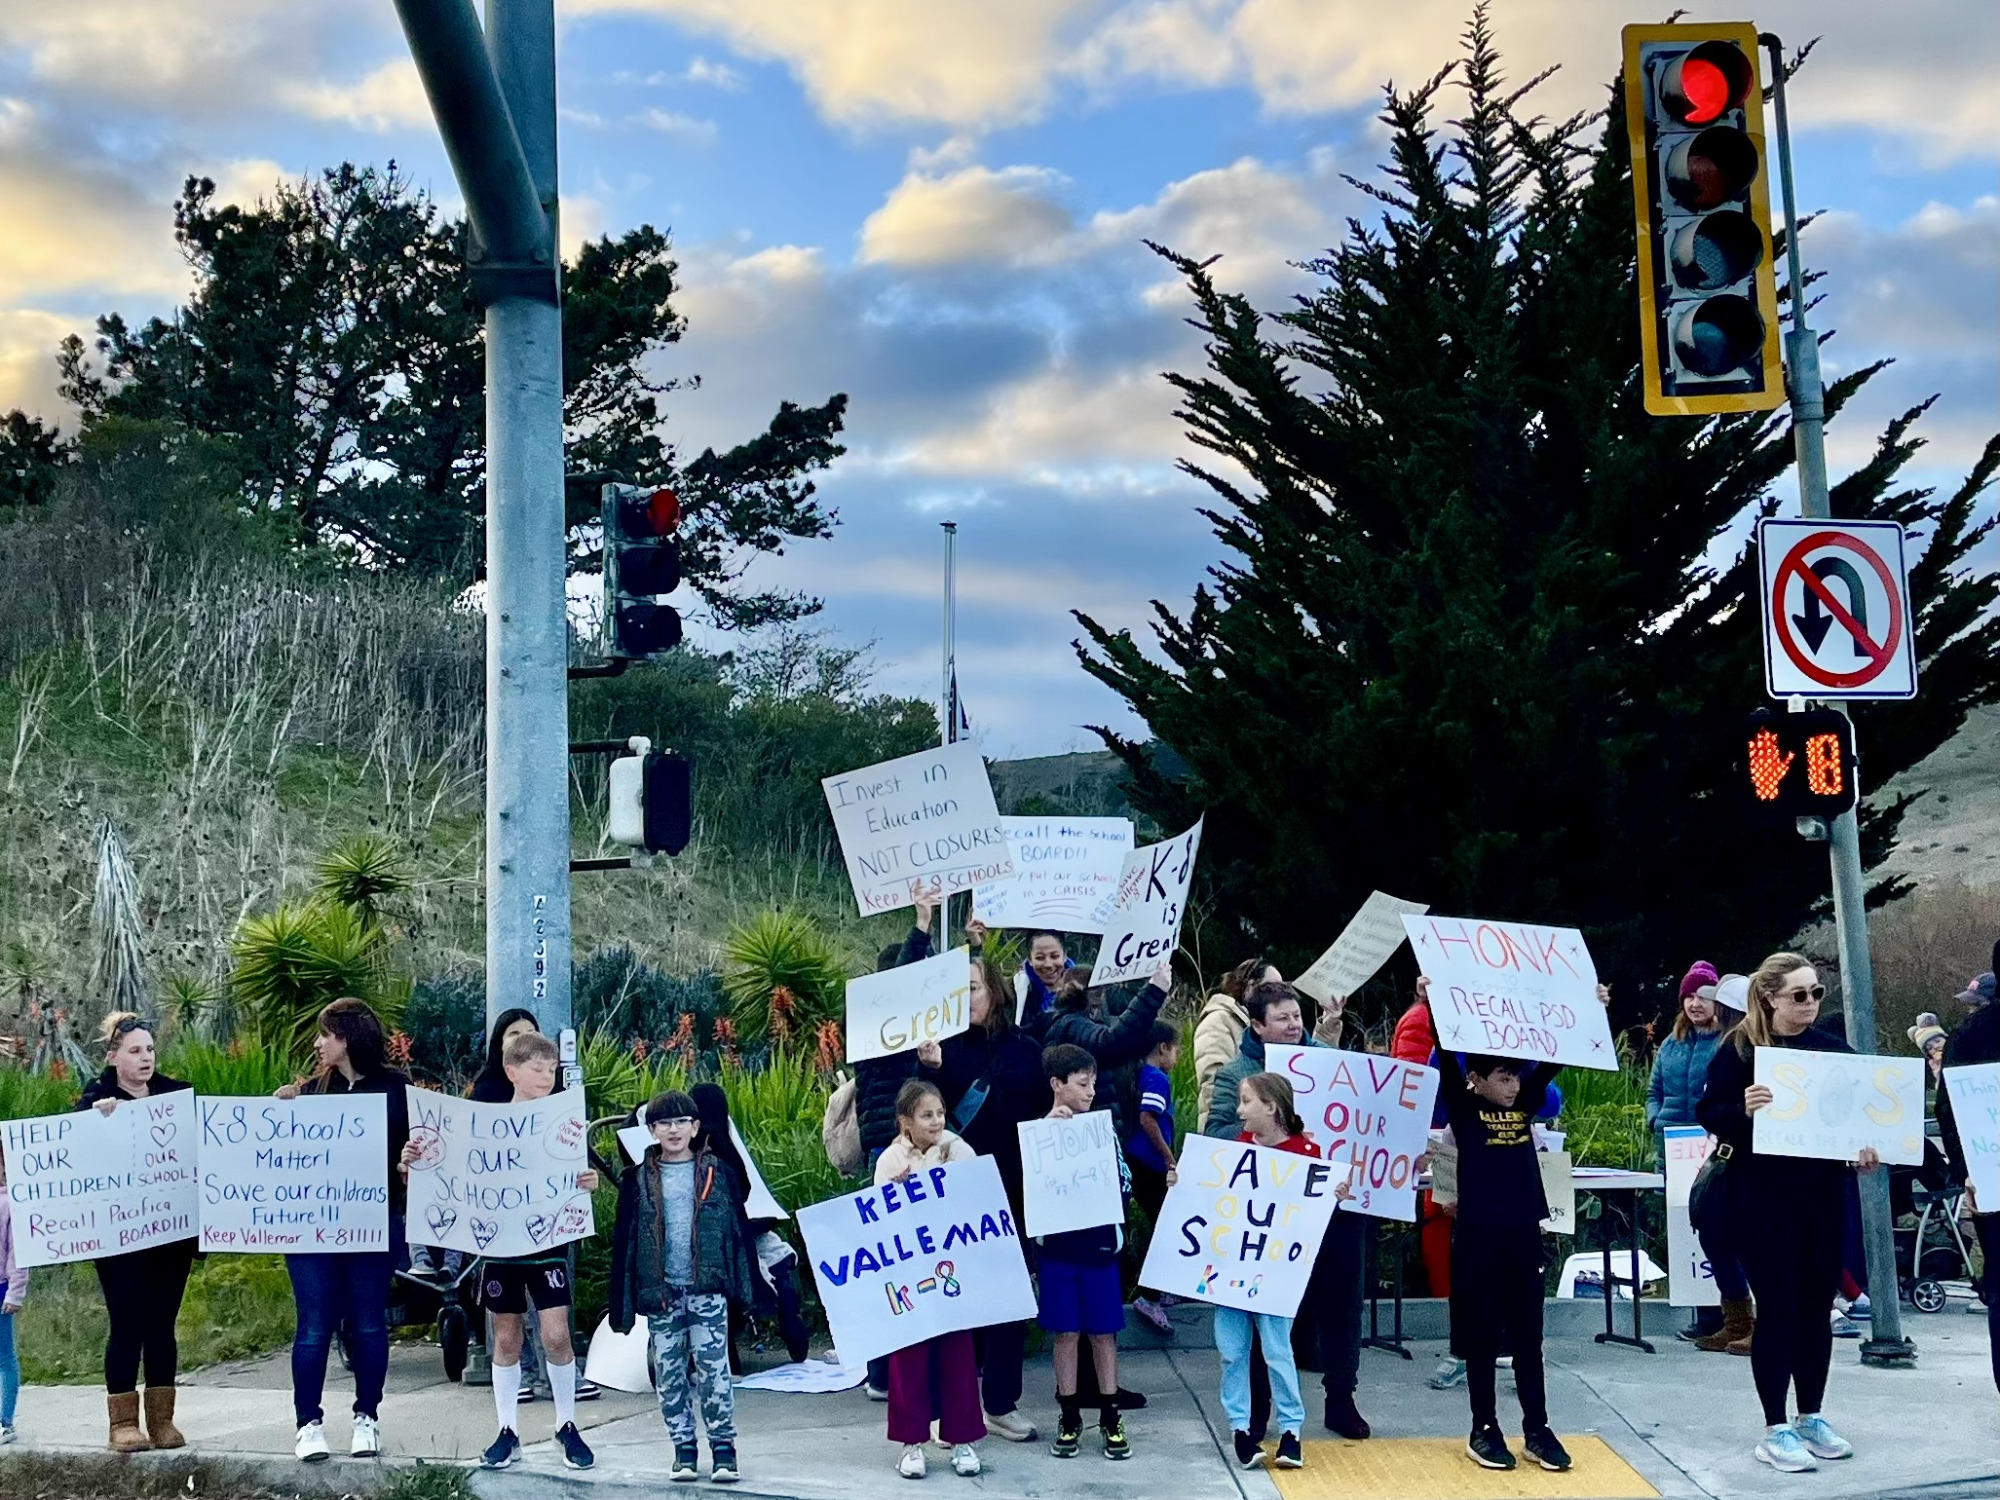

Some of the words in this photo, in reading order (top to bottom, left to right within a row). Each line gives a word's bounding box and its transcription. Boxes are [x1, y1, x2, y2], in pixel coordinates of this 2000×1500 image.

[831, 775, 902, 809] Invest
[924, 764, 947, 783] in
[866, 800, 958, 833] Education
[1003, 825, 1048, 842] ecall
[1060, 826, 1084, 838] the
[858, 845, 901, 879] NOT
[909, 826, 1005, 868] CLOSURES
[1145, 834, 1193, 903] K-8
[861, 888, 899, 912] Keep
[948, 860, 1013, 892] SCHOOLS
[1023, 889, 1034, 898] in
[1054, 886, 1097, 896] CRISIS
[1030, 870, 1047, 882] put
[1053, 872, 1070, 880] our
[1162, 903, 1177, 926] is
[1430, 920, 1581, 980] HONK
[1449, 986, 1535, 1025] RECALL
[1539, 1001, 1577, 1030] PSD
[1480, 1020, 1559, 1058] BOARD
[1288, 1053, 1424, 1111] SAVE
[1952, 1074, 2000, 1097] Thin
[148, 1102, 176, 1121] We
[202, 1100, 248, 1148] K-8
[255, 1107, 366, 1143] Schools
[471, 1111, 545, 1140] LOVE
[1324, 1102, 1387, 1138] OUR
[9, 1120, 73, 1150] HELP
[1023, 1112, 1114, 1175] HONK
[22, 1149, 74, 1177] OUR
[145, 1153, 179, 1168] OUR
[256, 1148, 330, 1170] Matter!
[467, 1147, 528, 1175] OUR
[1197, 1149, 1332, 1197] SAVE
[204, 1173, 268, 1205] Save
[275, 1183, 313, 1202] our
[315, 1177, 388, 1204] childrens
[854, 1166, 948, 1225] KEEP
[30, 1210, 96, 1239] Recall
[109, 1197, 172, 1225] Pacifica
[252, 1206, 340, 1226] Future!!!
[47, 1236, 106, 1260] SCHOOL
[203, 1225, 236, 1246] Keep
[241, 1226, 304, 1245] Vallemar
[819, 1209, 1016, 1287] VALLEMAR
[1196, 1264, 1264, 1299] K-8
